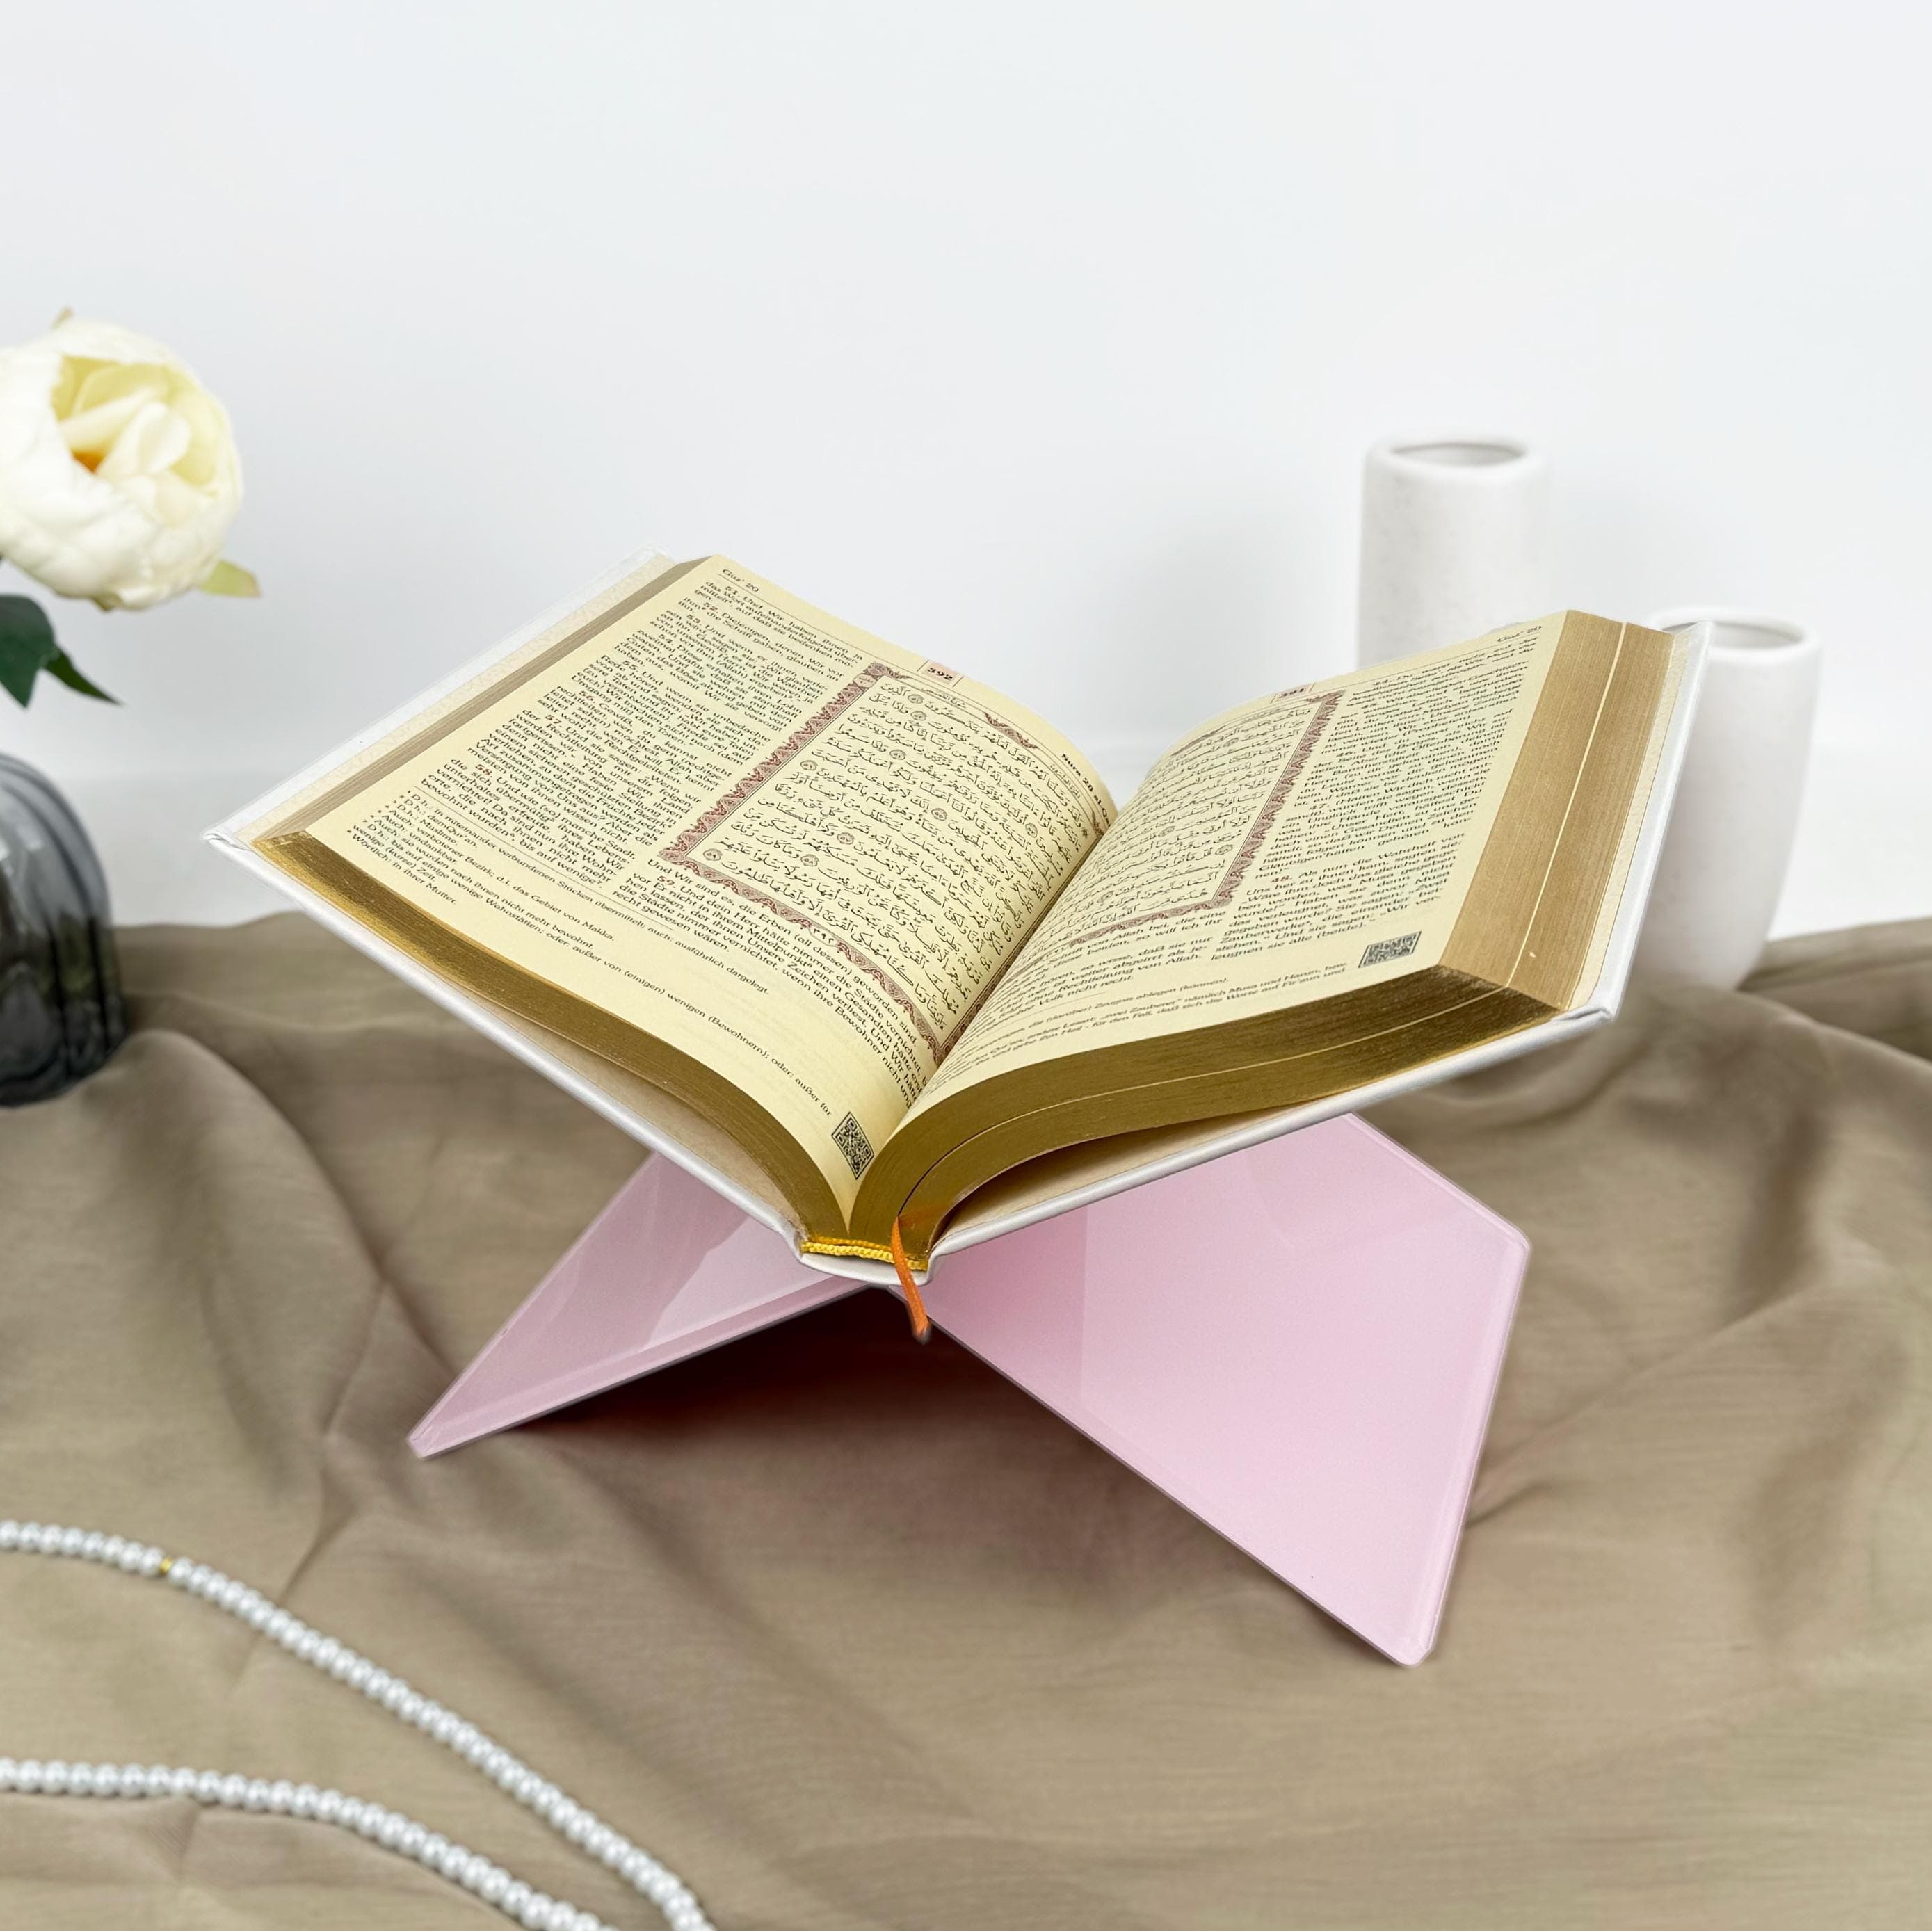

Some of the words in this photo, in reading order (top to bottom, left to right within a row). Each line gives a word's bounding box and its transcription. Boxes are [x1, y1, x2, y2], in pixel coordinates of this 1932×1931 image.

[746, 583, 759, 592] 20
[927, 666, 953, 680] 392
[522, 709, 540, 720] der
[545, 723, 607, 763] Rechtleitung
[613, 765, 631, 775] mit
[637, 778, 652, 786] dir
[537, 699, 558, 712] sehr
[561, 713, 586, 729] wohl
[586, 729, 602, 740] die
[467, 748, 507, 774] meisten
[509, 773, 529, 788] von
[531, 787, 561, 807] ihnen
[563, 806, 597, 827] wissen
[516, 714, 552, 738] werden
[560, 741, 576, 752] wir
[583, 755, 602, 768] von
[609, 771, 653, 796] unserem
[661, 797, 690, 814] Land
[565, 726, 588, 742] Und
[590, 743, 604, 752] sie
[684, 793, 701, 802] wir
[444, 763, 500, 801] unterhaltes
[561, 834, 595, 856] haben
[606, 857, 625, 870] Wir
[444, 816, 496, 848] miteinander
[498, 848, 555, 882] verbundenen
[458, 793, 476, 805] die
[481, 807, 506, 825] nach
[512, 826, 542, 846] ihnen
[549, 848, 577, 864] nicht
[581, 865, 611, 882] mehr
[496, 776, 520, 793] Und
[520, 792, 538, 805] wie
[539, 804, 561, 818] (so)
[561, 817, 604, 841] manche
[612, 891, 641, 906] recht
[641, 905, 690, 931] gewesen
[647, 859, 672, 874] Und
[675, 871, 693, 884] Wir
[695, 883, 720, 896] sind
[739, 905, 756, 915] die
[758, 913, 791, 935] Erben
[794, 933, 812, 946] (all
[812, 946, 852, 975] dessen)
[852, 976, 898, 1020] geworden
[679, 885, 705, 900] Und
[706, 900, 730, 914] dein
[734, 912, 759, 928] Herr
[762, 926, 789, 945] hätte
[792, 946, 834, 973] nimmer
[835, 975, 851, 988] die
[853, 988, 883, 1019] Städte
[619, 885, 637, 895] die
[638, 894, 675, 914] Städte
[677, 912, 721, 936] nimmer
[782, 969, 810, 990] wenn
[813, 989, 833, 1006] ihre
[835, 1005, 882, 1054] Bewohner
[882, 1056, 900, 1083] nicht
[625, 878, 647, 891] hen
[690, 910, 709, 921] der
[712, 921, 743, 939] ihnen
[747, 937, 784, 962] Unsere
[787, 961, 828, 992] Zeichen
[870, 1027, 889, 1051] Und
[891, 1051, 903, 1072] Wir
[633, 873, 651, 884] vor
[653, 882, 667, 891] Er
[668, 891, 697, 906] nicht
[698, 904, 709, 912] in
[711, 911, 743, 930] ihrem
[813, 970, 841, 992] einen
[844, 992, 892, 1042] Gesandten
[893, 1042, 911, 1070] hätte
[572, 946, 601, 961] außer
[604, 961, 621, 972] von
[624, 971, 665, 994] (einigen)
[667, 993, 705, 1017] wenigen
[795, 1078, 819, 1101] außer
